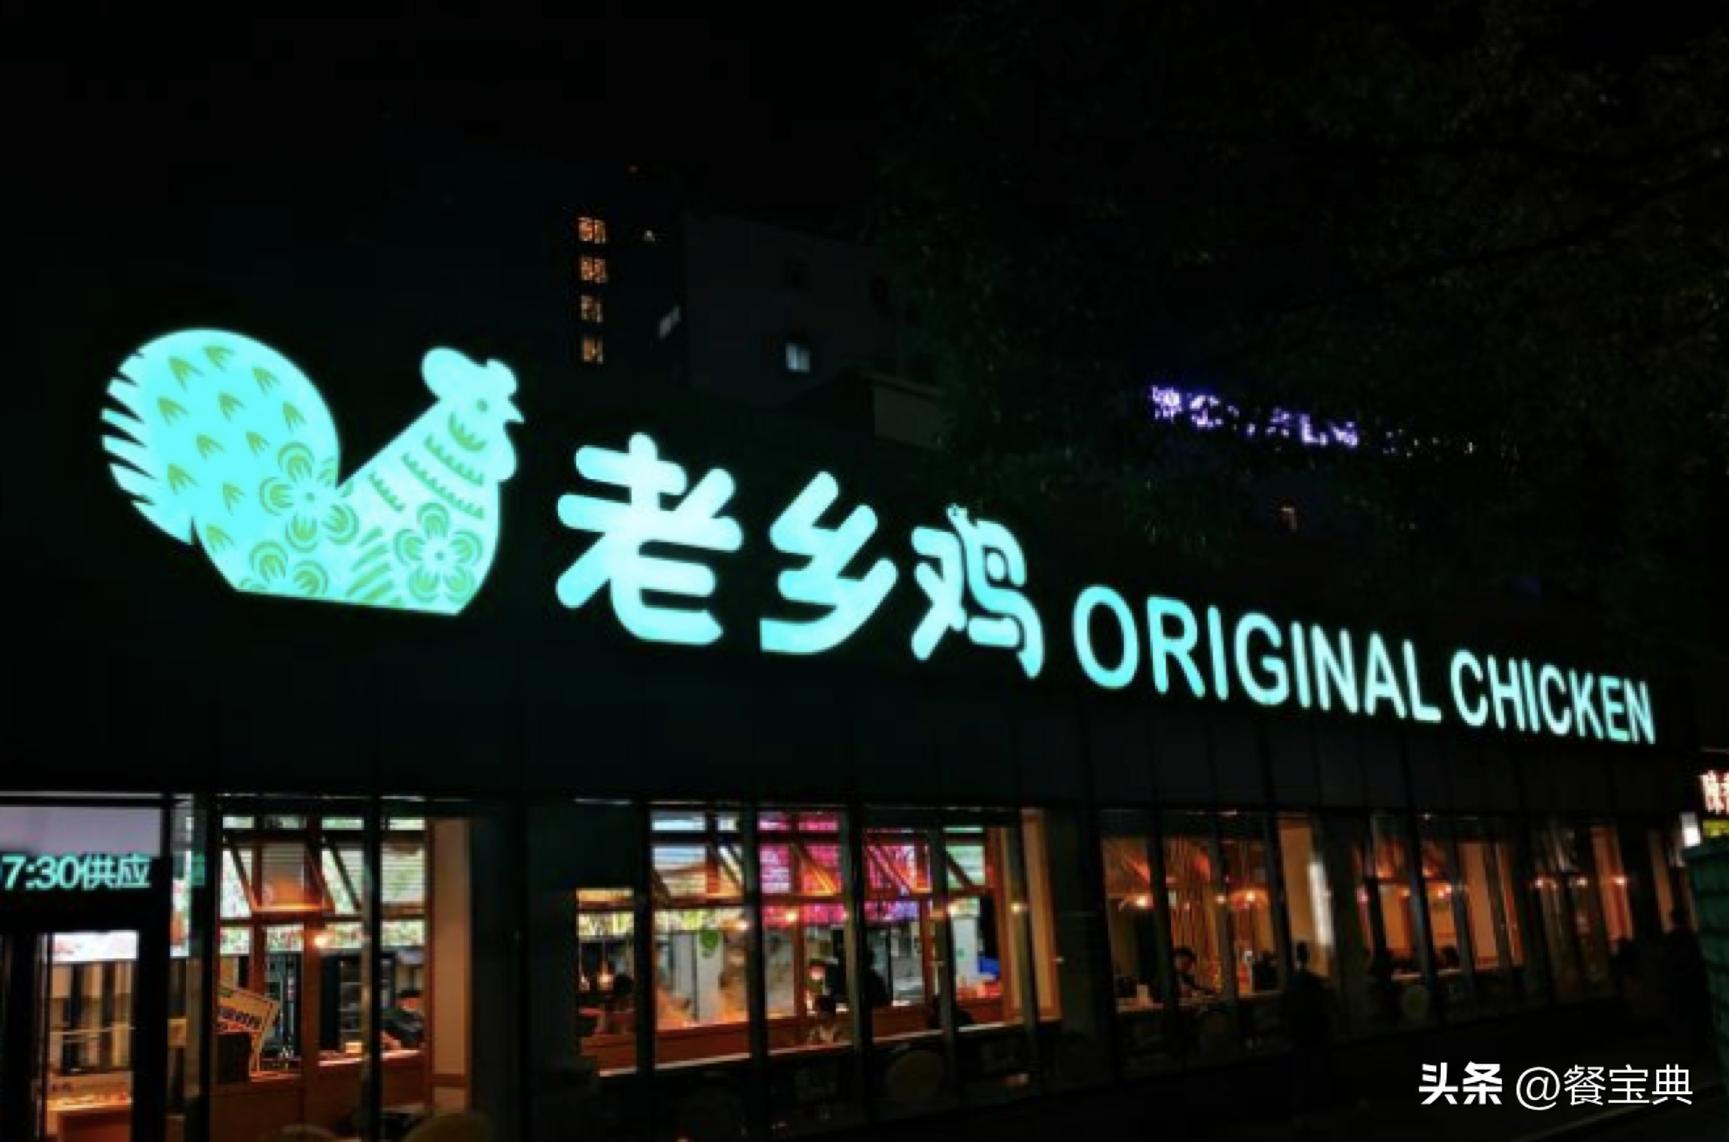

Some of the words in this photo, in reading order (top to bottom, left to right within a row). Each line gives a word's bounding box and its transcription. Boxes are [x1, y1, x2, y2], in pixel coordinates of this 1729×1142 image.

[555, 432, 1044, 679] 老乡鸡
[1072, 585, 1442, 724] ORIGINAL
[1450, 649, 1656, 745] CHICKEN
[0, 854, 152, 891] 7:30供应
